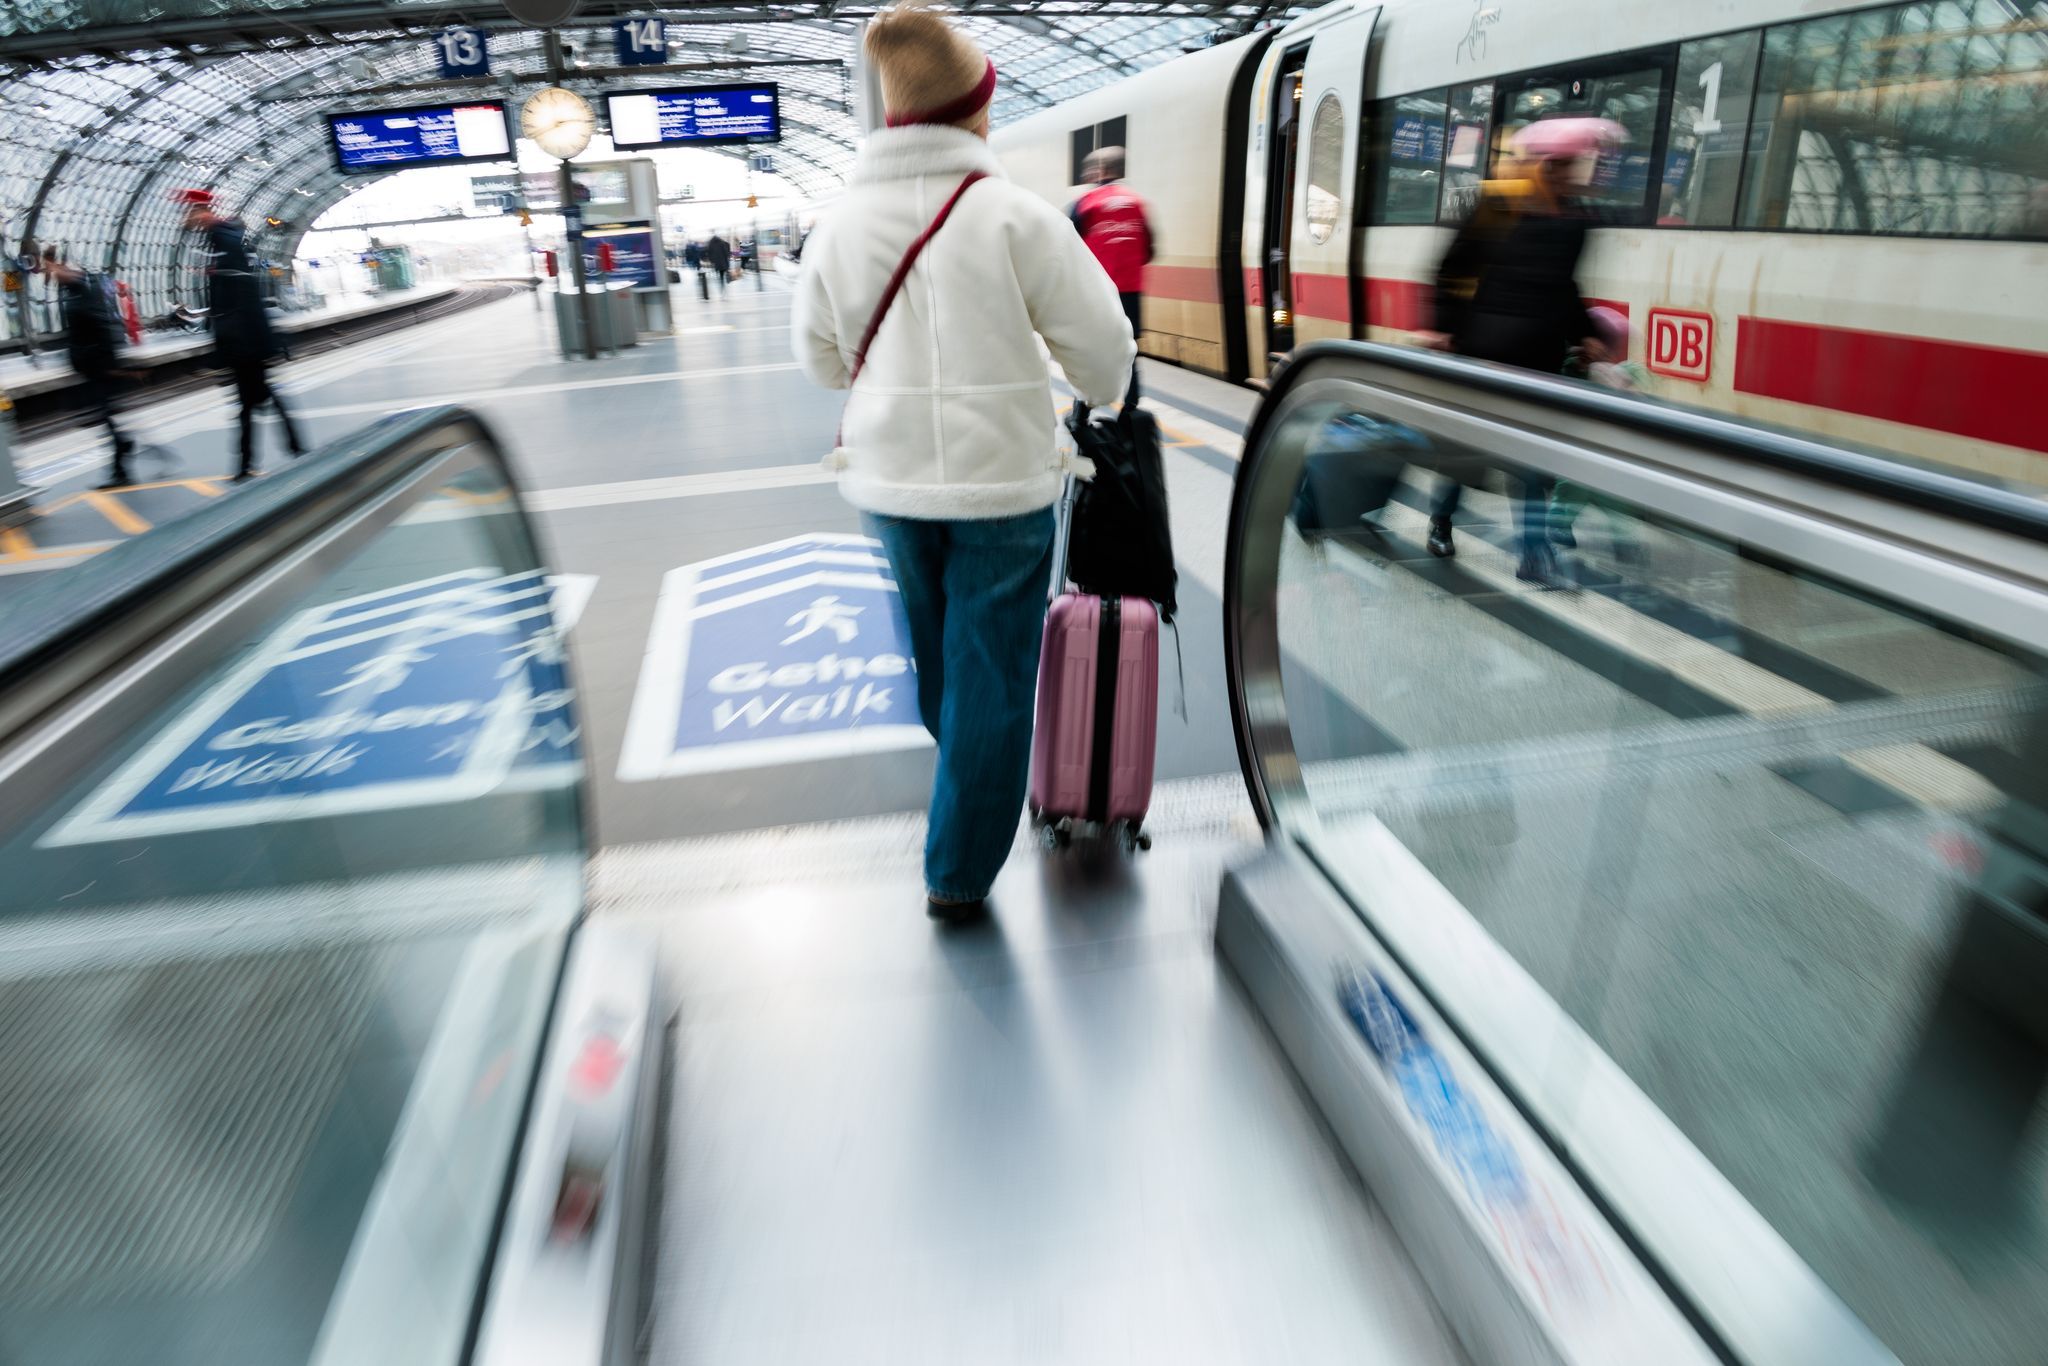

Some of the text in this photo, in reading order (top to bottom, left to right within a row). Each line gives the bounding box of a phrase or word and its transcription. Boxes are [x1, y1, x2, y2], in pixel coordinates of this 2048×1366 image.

[436, 30, 482, 66] 13
[624, 19, 666, 52] 14
[1693, 61, 1723, 134] 1
[1655, 319, 1703, 368] DB
[707, 653, 918, 693] Gehe
[712, 682, 894, 732] Walk
[164, 741, 374, 796] Walk
